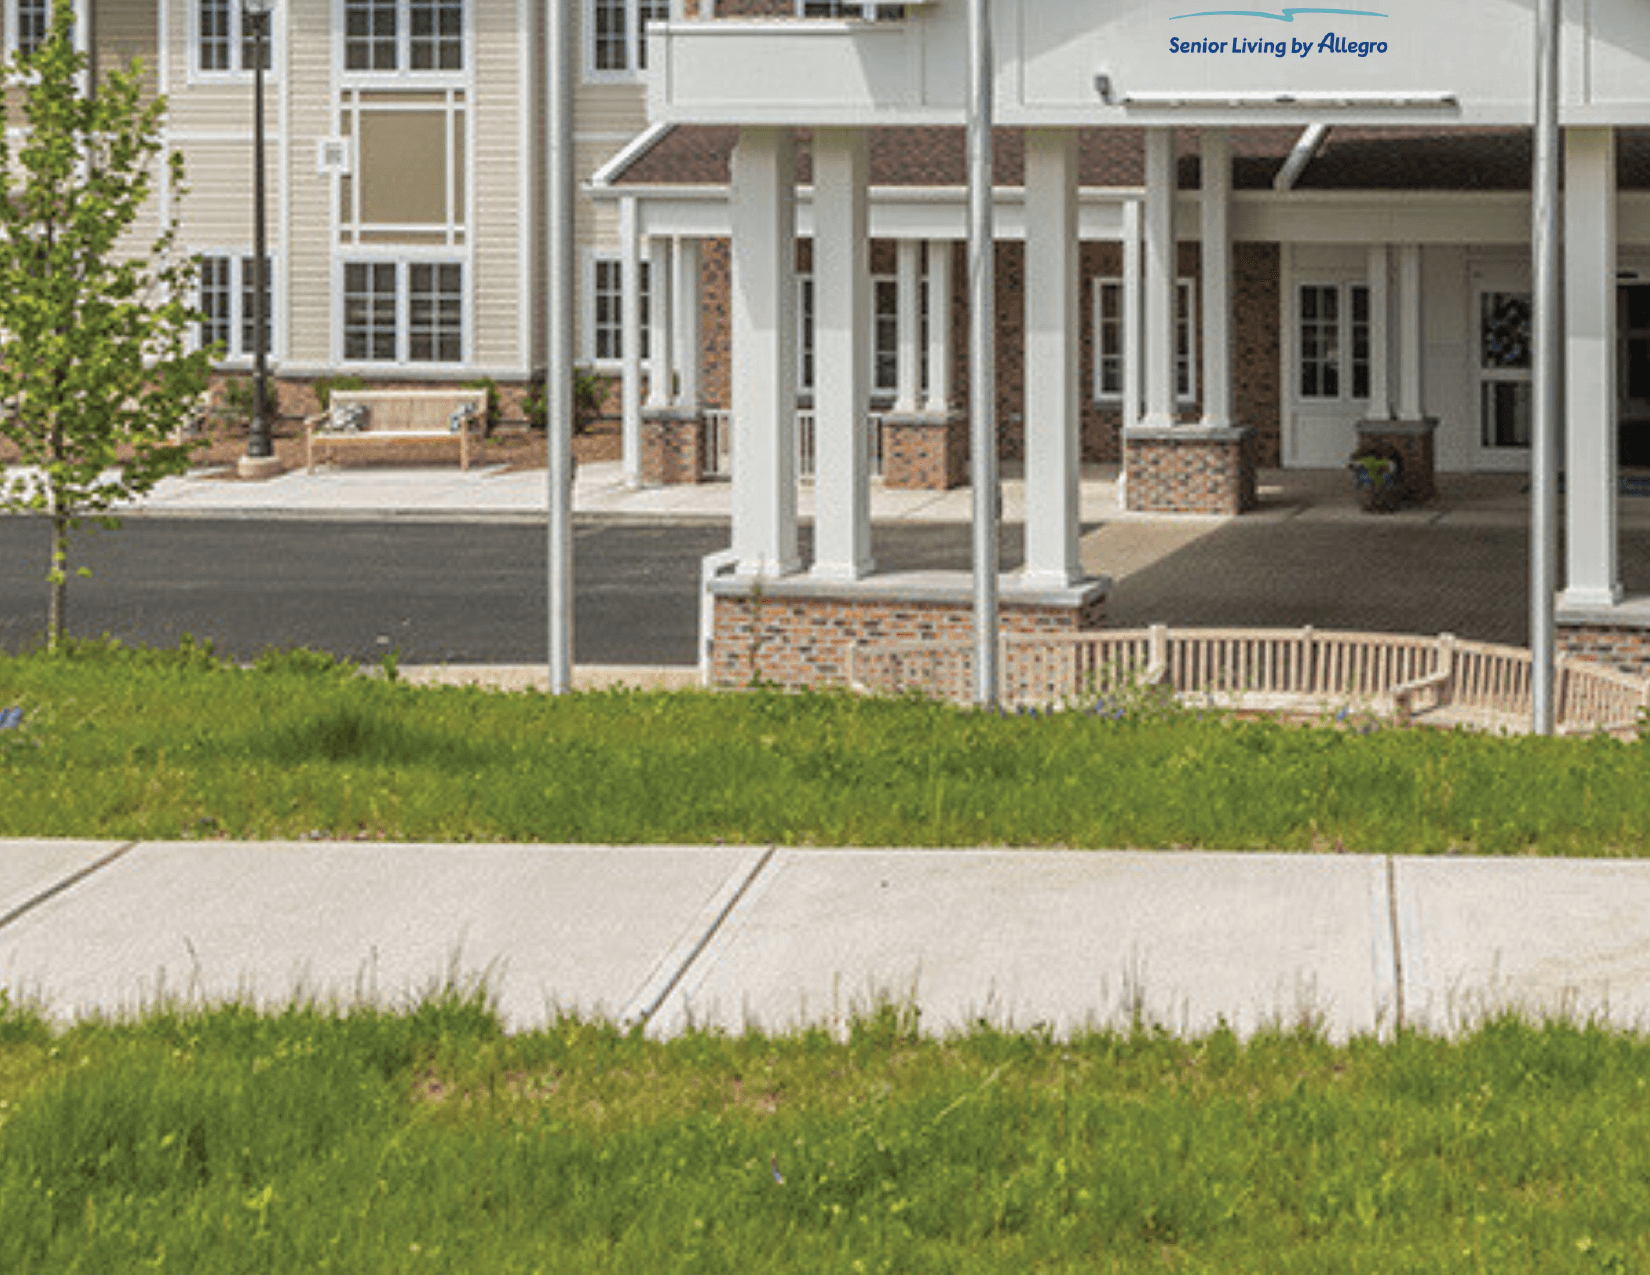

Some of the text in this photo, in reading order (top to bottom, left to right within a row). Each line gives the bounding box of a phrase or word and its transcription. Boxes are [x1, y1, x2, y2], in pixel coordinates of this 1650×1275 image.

[1168, 31, 1389, 58] Senior Living by Allegro
